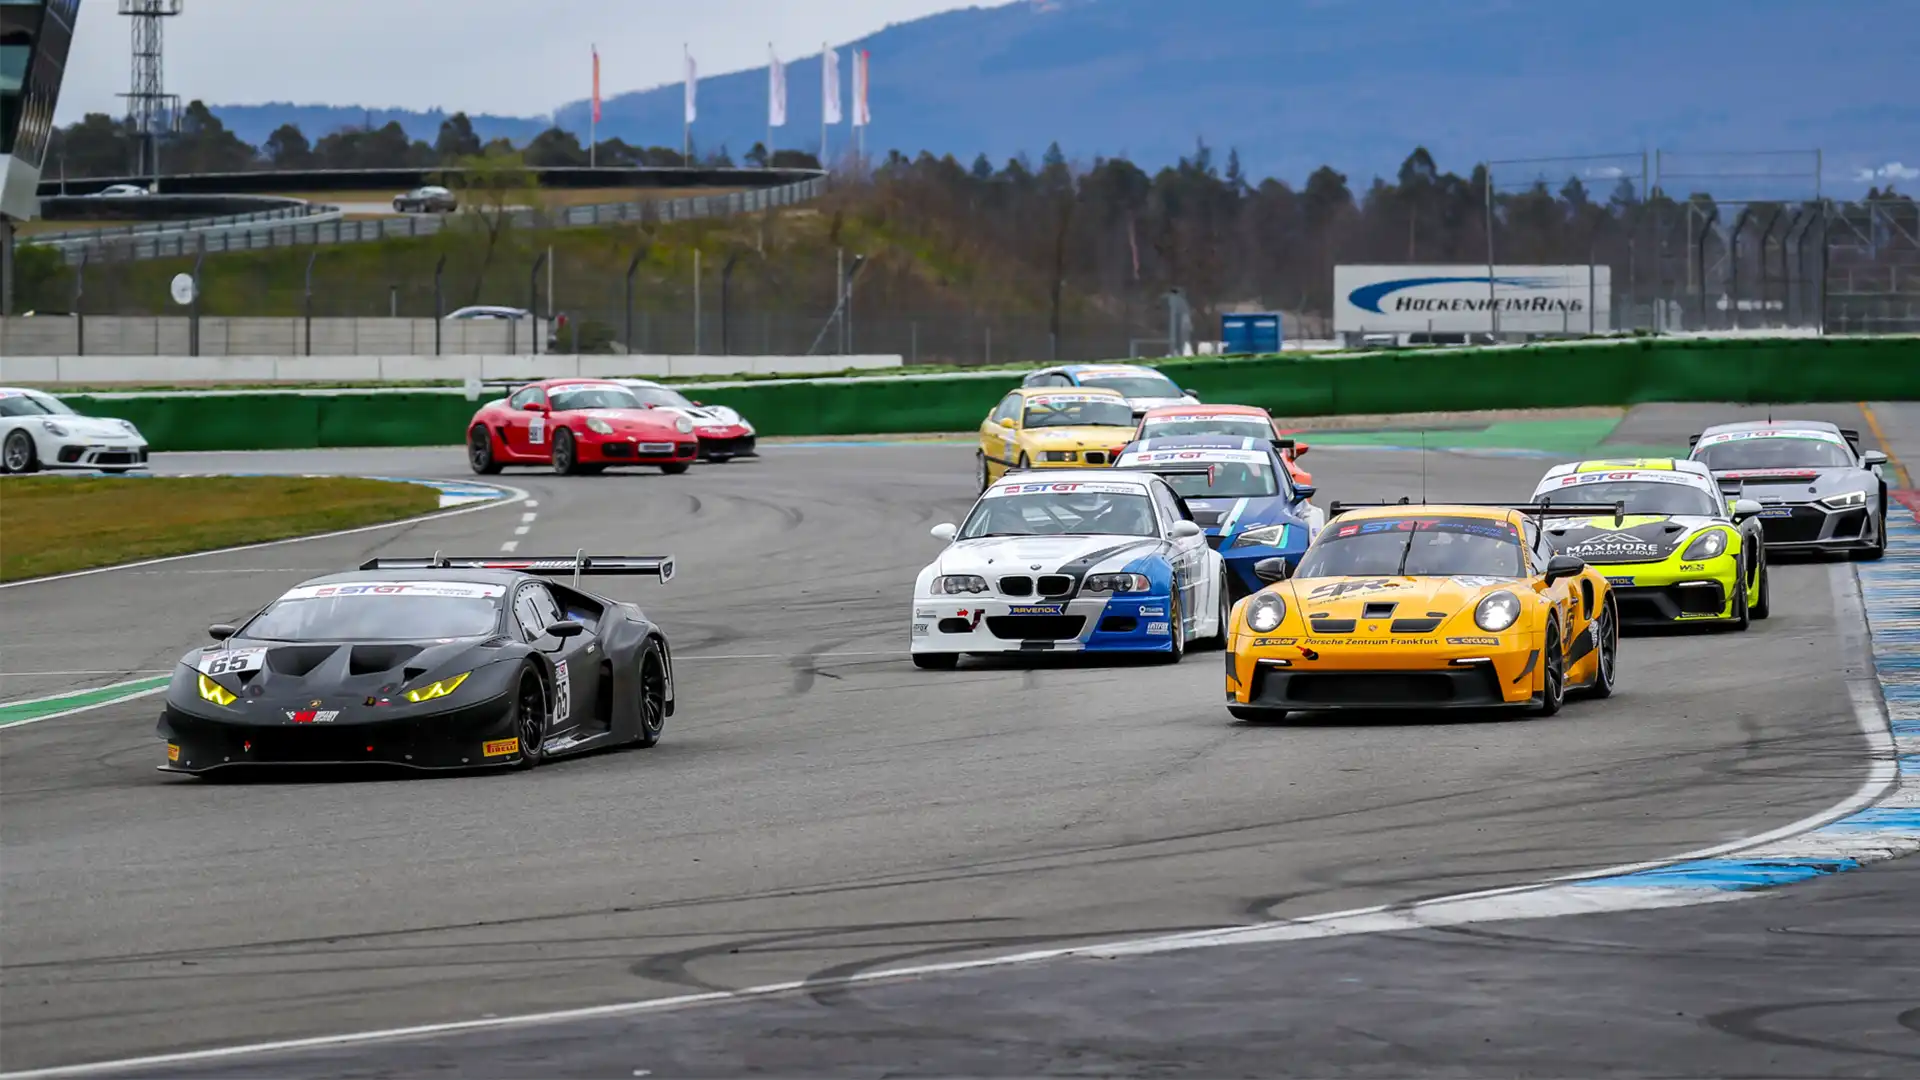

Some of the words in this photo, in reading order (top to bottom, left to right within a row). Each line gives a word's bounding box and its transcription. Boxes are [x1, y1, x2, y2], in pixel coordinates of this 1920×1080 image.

[1153, 452, 1206, 461] STGT
[1580, 472, 1638, 482] STGT
[1022, 483, 1083, 492] STGT
[1360, 520, 1440, 534] STGT
[1566, 543, 1658, 554] MAXMORE
[1567, 550, 1624, 558] TECHNOLOGY
[338, 585, 412, 594] STGT
[208, 654, 250, 675] 65
[486, 740, 517, 753] PIRELLI
